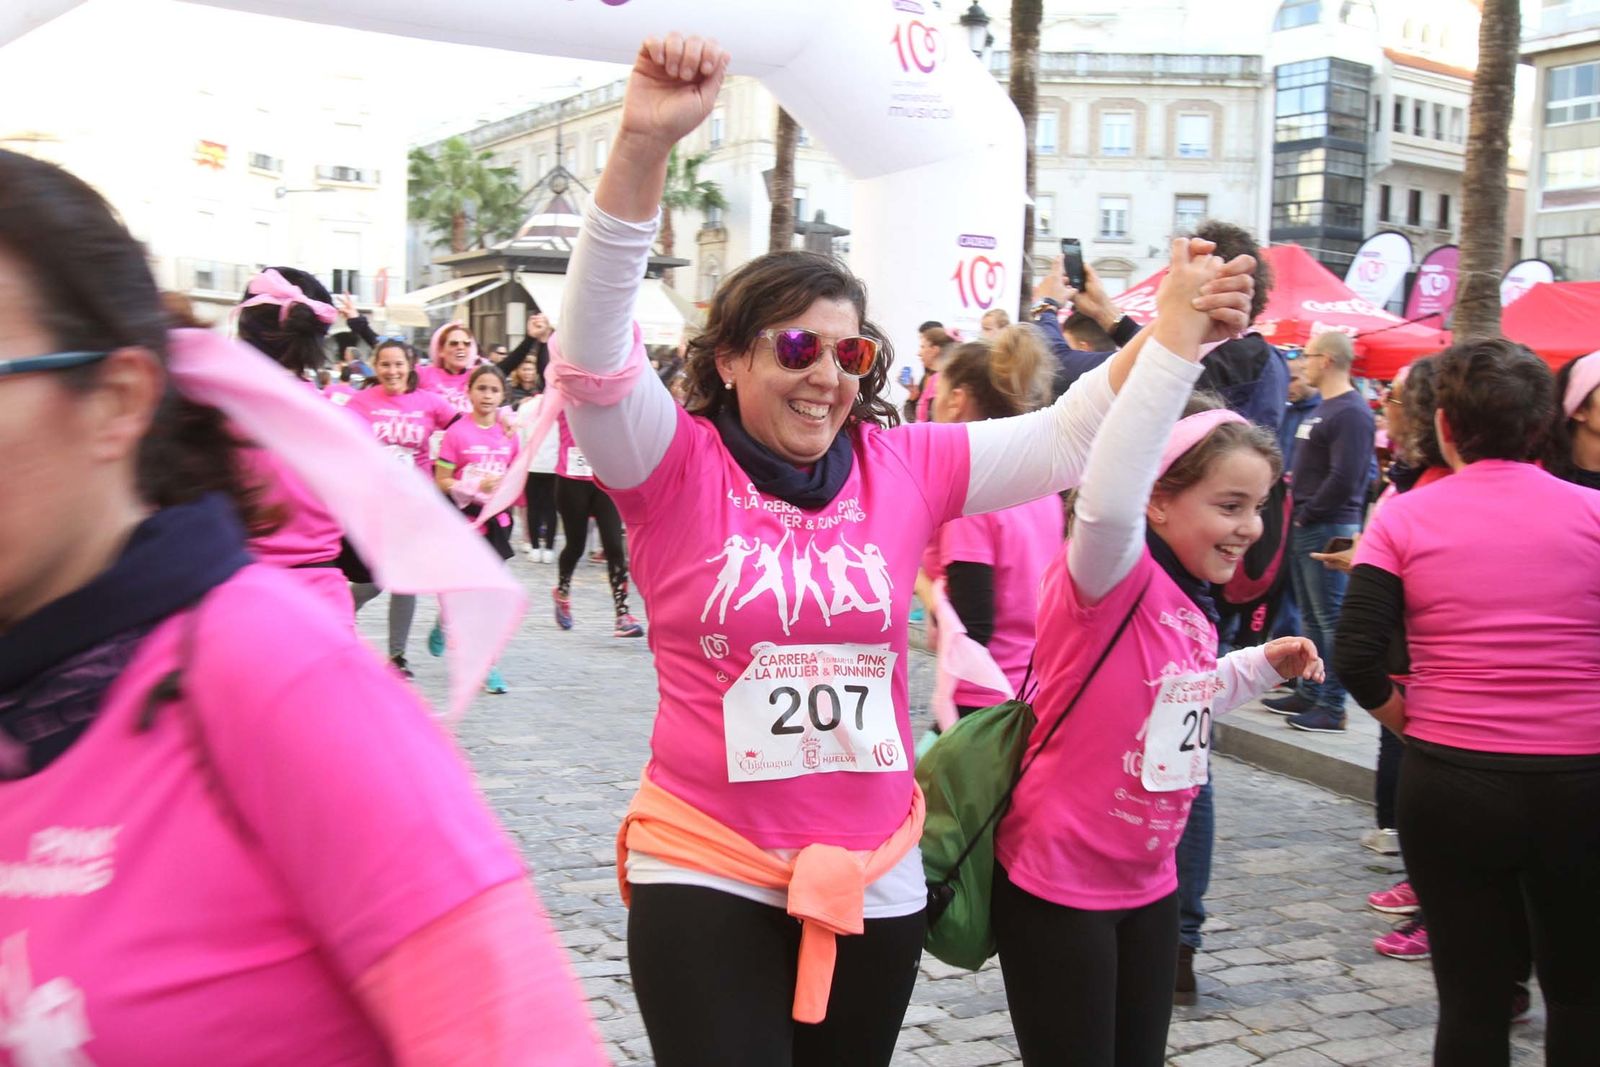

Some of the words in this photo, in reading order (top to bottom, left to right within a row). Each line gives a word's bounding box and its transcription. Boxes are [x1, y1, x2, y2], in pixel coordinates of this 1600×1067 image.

[805, 519, 815, 530] &
[759, 653, 818, 666] CARRERA
[857, 653, 887, 666] PINK
[755, 668, 771, 680] LA
[775, 665, 819, 679] MUJER
[823, 668, 830, 677] &
[833, 664, 886, 679] RUNNING
[769, 684, 869, 735] 207
[822, 753, 857, 764] HUELVA
